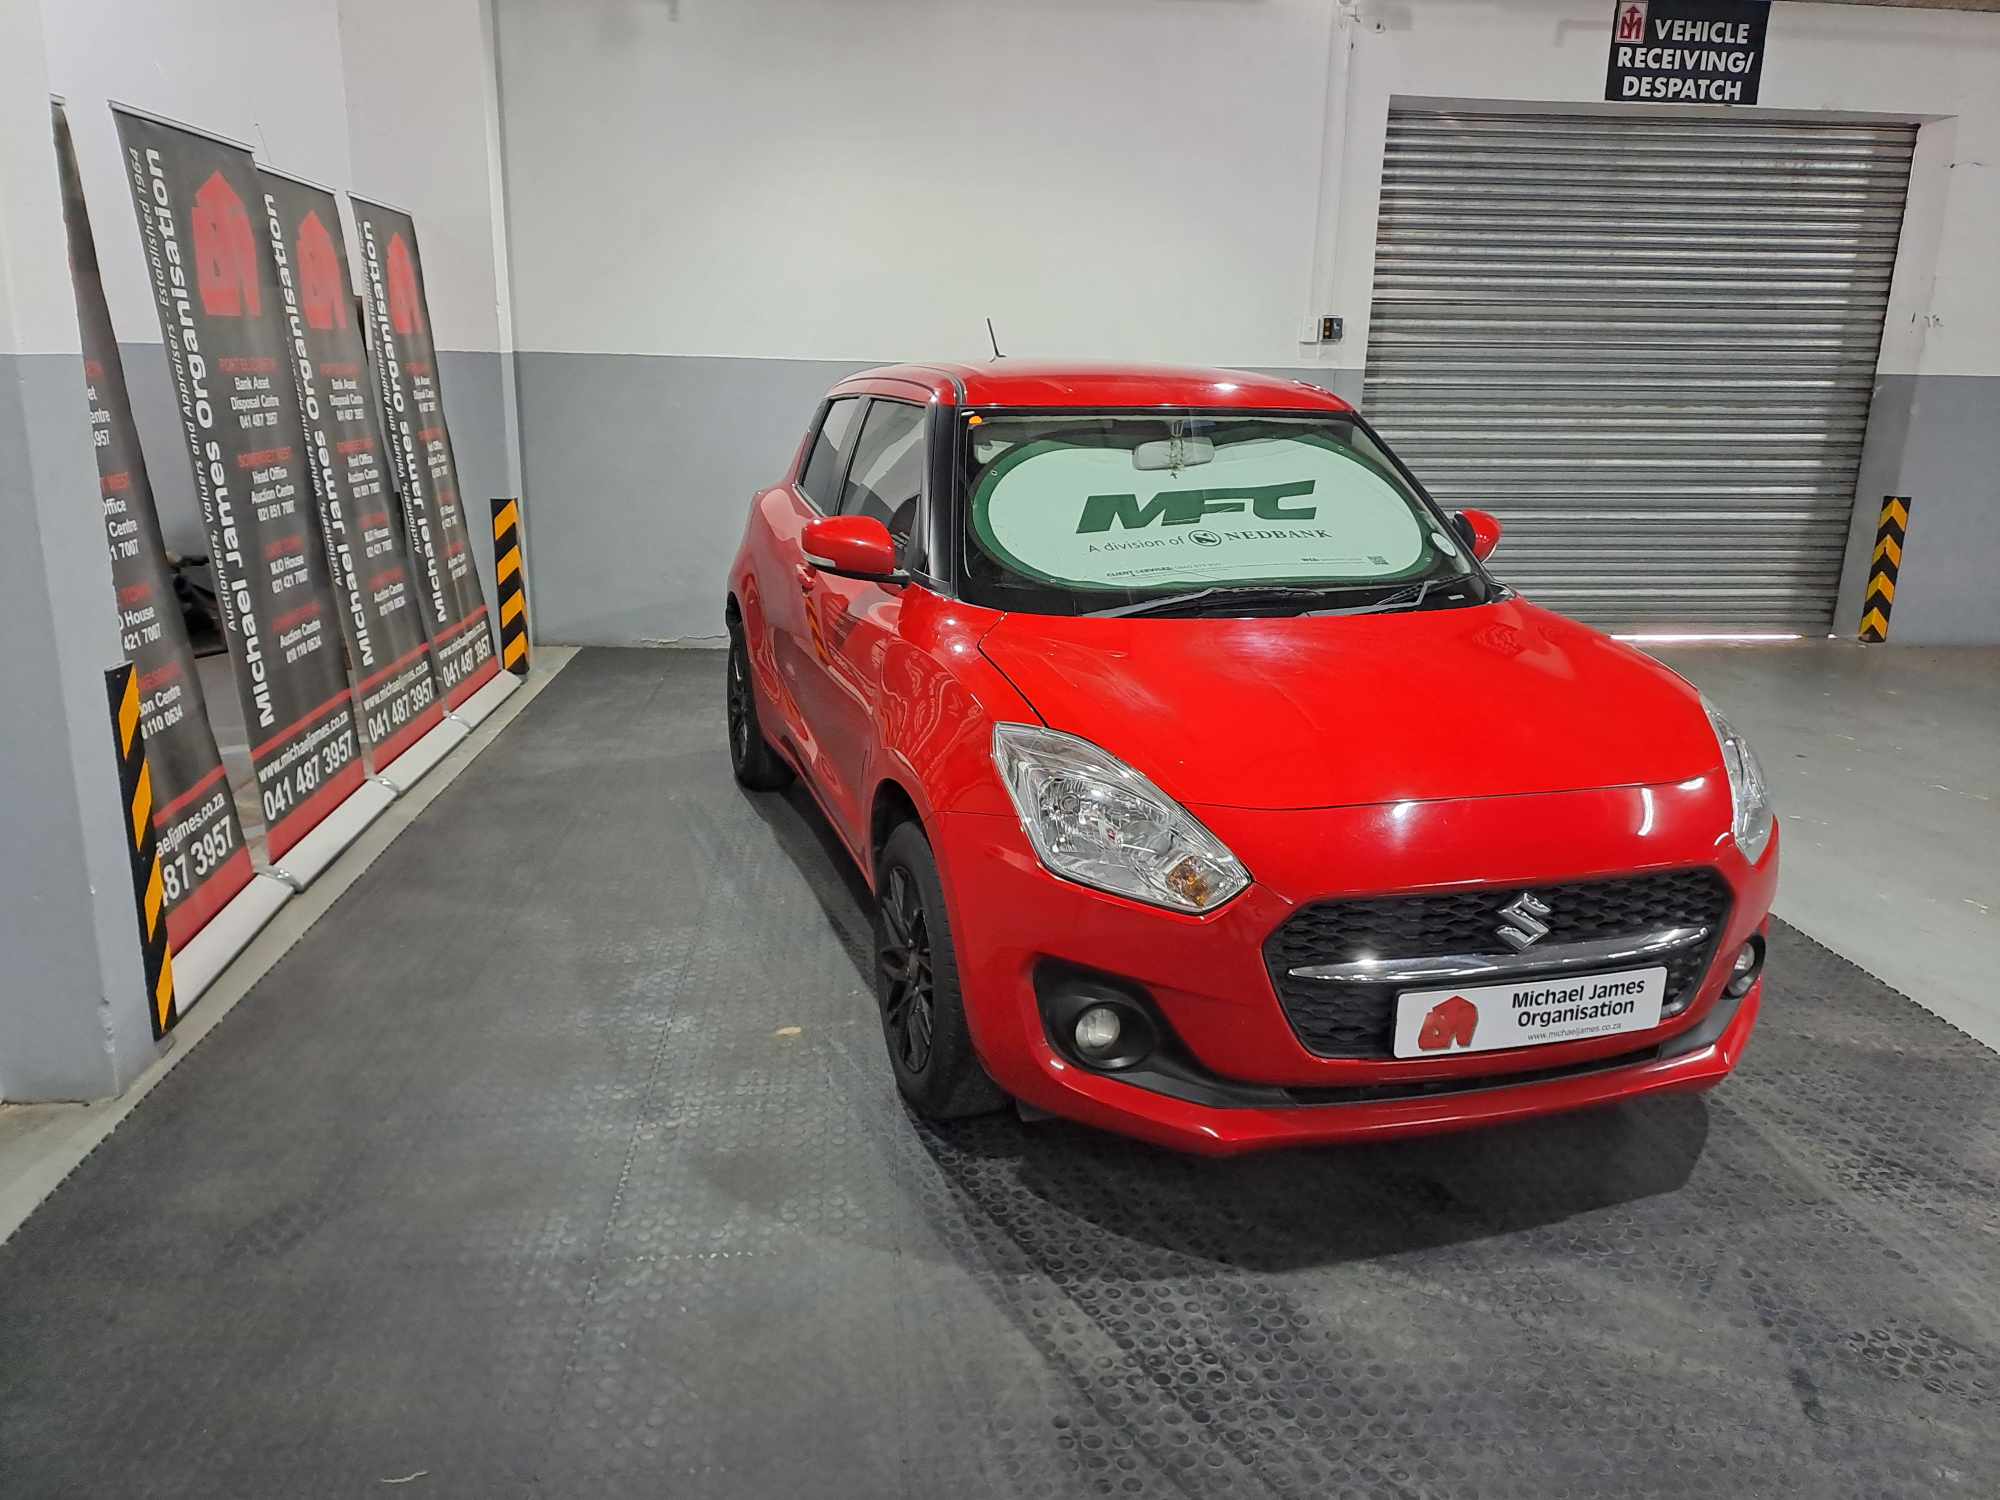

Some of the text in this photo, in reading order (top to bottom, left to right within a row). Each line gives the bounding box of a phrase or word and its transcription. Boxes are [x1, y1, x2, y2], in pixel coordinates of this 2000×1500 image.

[1654, 18, 1751, 44] VEHICLE
[1617, 46, 1755, 74] RECEIVING/
[1622, 75, 1742, 101] DESPATCH
[128, 146, 149, 194] 1964
[139, 199, 170, 306] Established
[263, 193, 320, 421] Organisation
[362, 221, 405, 413] Organisation
[165, 322, 193, 416] Appraisers
[90, 407, 111, 424] entre
[93, 429, 110, 447] 957
[146, 148, 276, 728] Michael James Organisation
[186, 420, 200, 455] and
[385, 406, 397, 431] and
[304, 443, 323, 497] Valuers
[315, 430, 347, 535] James
[400, 421, 425, 510] James
[194, 459, 214, 524] Valuers
[1075, 479, 1317, 534] MFC
[108, 518, 138, 538] Centre
[1088, 543, 1101, 553] A
[1104, 537, 1165, 552] division
[1168, 535, 1185, 547] of
[1222, 528, 1334, 542] NEDBANK
[210, 528, 239, 632] Auctioneers,
[417, 518, 448, 623] Michael
[123, 606, 155, 628] House
[337, 543, 375, 667] Michael
[124, 631, 142, 651] 421
[442, 658, 461, 688] 041
[460, 647, 474, 675] 487
[155, 685, 182, 708] Centre
[367, 676, 434, 744] 041 487 3957
[147, 714, 164, 736] 110
[263, 729, 353, 821] 041 487 3957
[155, 792, 226, 859] aeljames.co.za
[162, 814, 234, 907] 87 3957
[1511, 979, 1646, 1009] Michael James
[1517, 1000, 1635, 1028] Organisation
[1526, 1021, 1623, 1042] www.michaeljames.co.za
